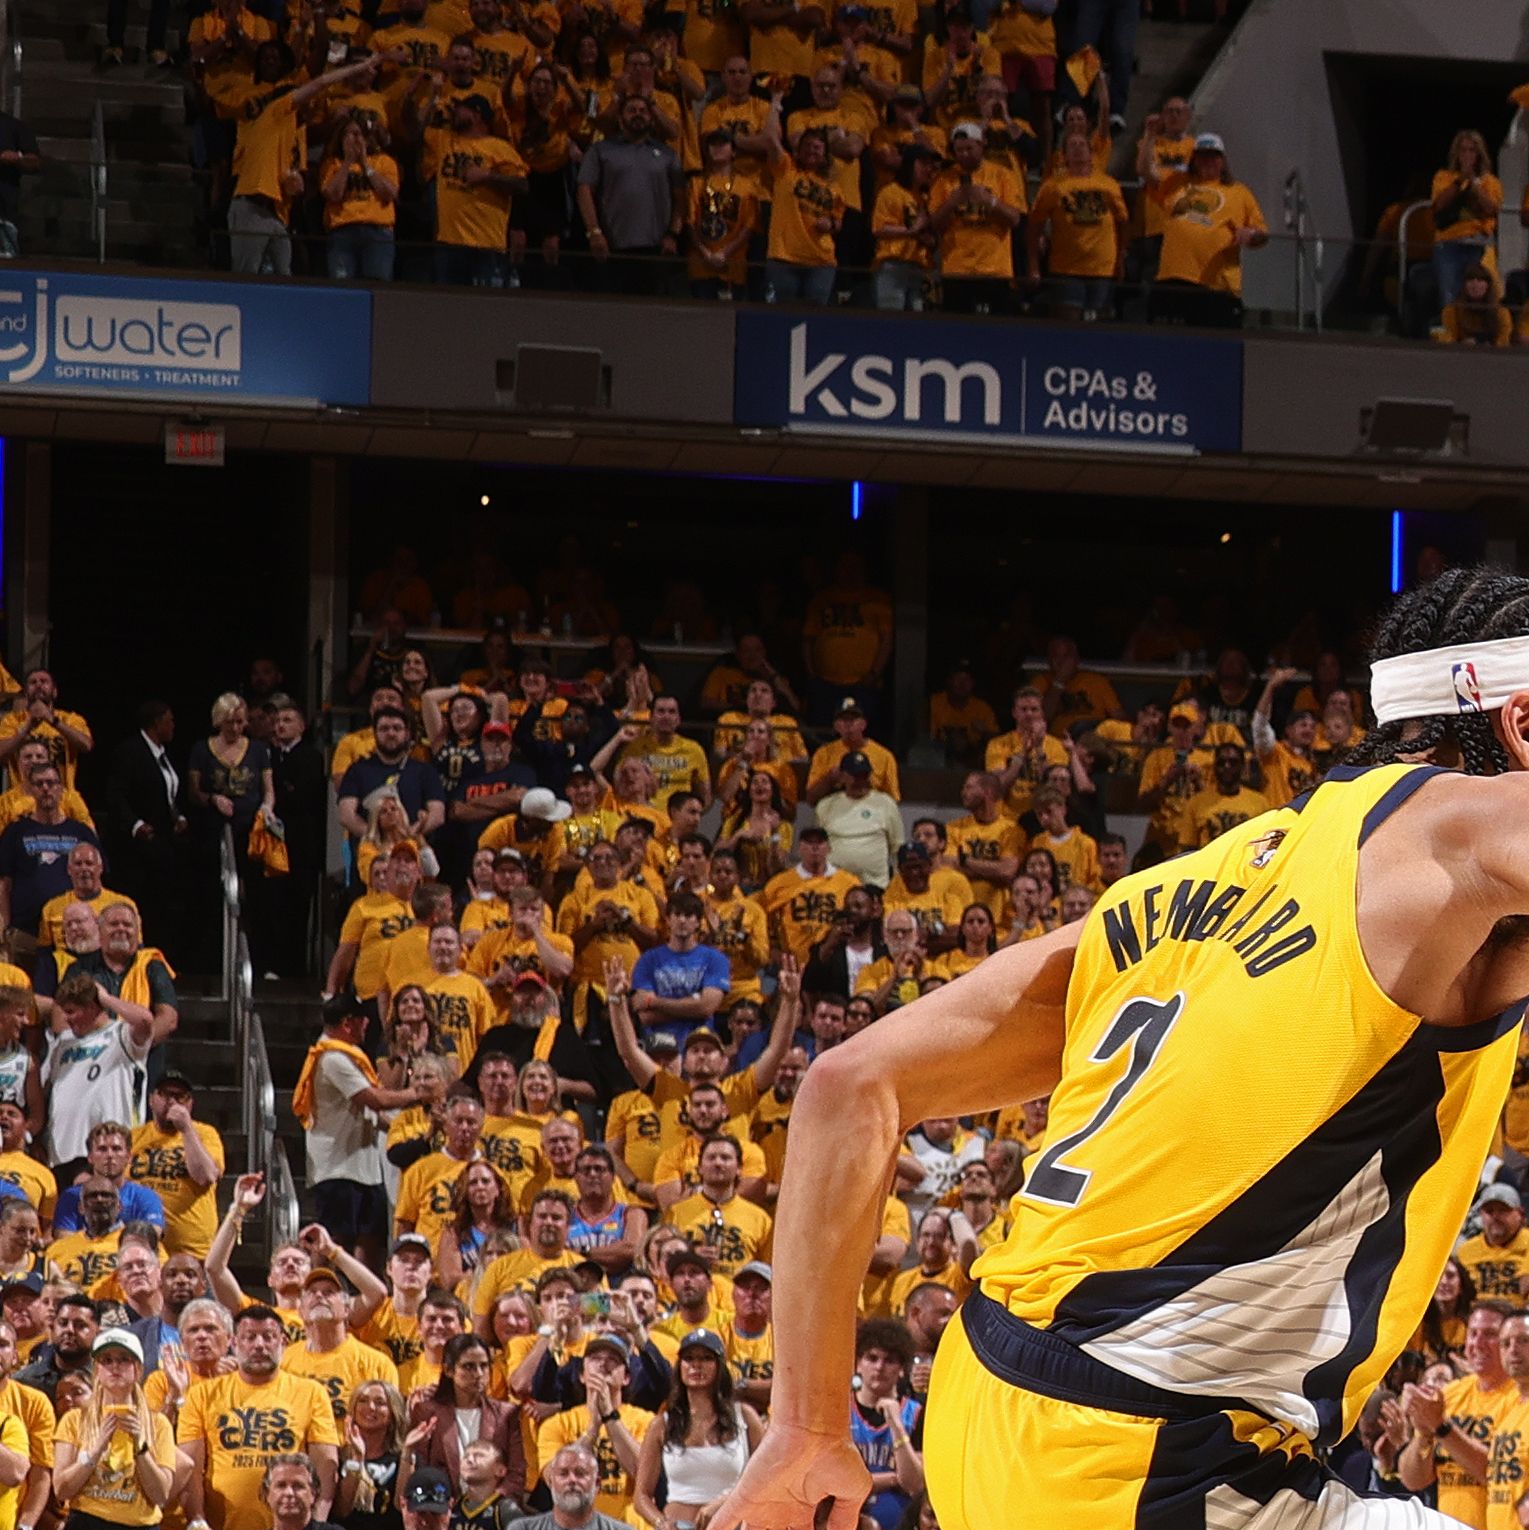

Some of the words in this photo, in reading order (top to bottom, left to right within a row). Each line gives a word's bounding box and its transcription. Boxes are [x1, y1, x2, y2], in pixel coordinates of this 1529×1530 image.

[62, 306, 234, 359] water
[55, 365, 141, 381] SOFTENERS
[155, 370, 241, 386] TREATMENT
[788, 322, 1002, 425] ksm
[1043, 367, 1126, 399] CPAs
[1132, 371, 1157, 400] &
[1043, 402, 1189, 436] Advisors
[87, 1064, 100, 1081] 0
[1020, 990, 1187, 1209] 2
[480, 1139, 518, 1160] YES
[78, 1250, 119, 1274] YES
[733, 1360, 774, 1381] YES
[233, 1405, 290, 1432] YES
[219, 1425, 297, 1452] CERS
